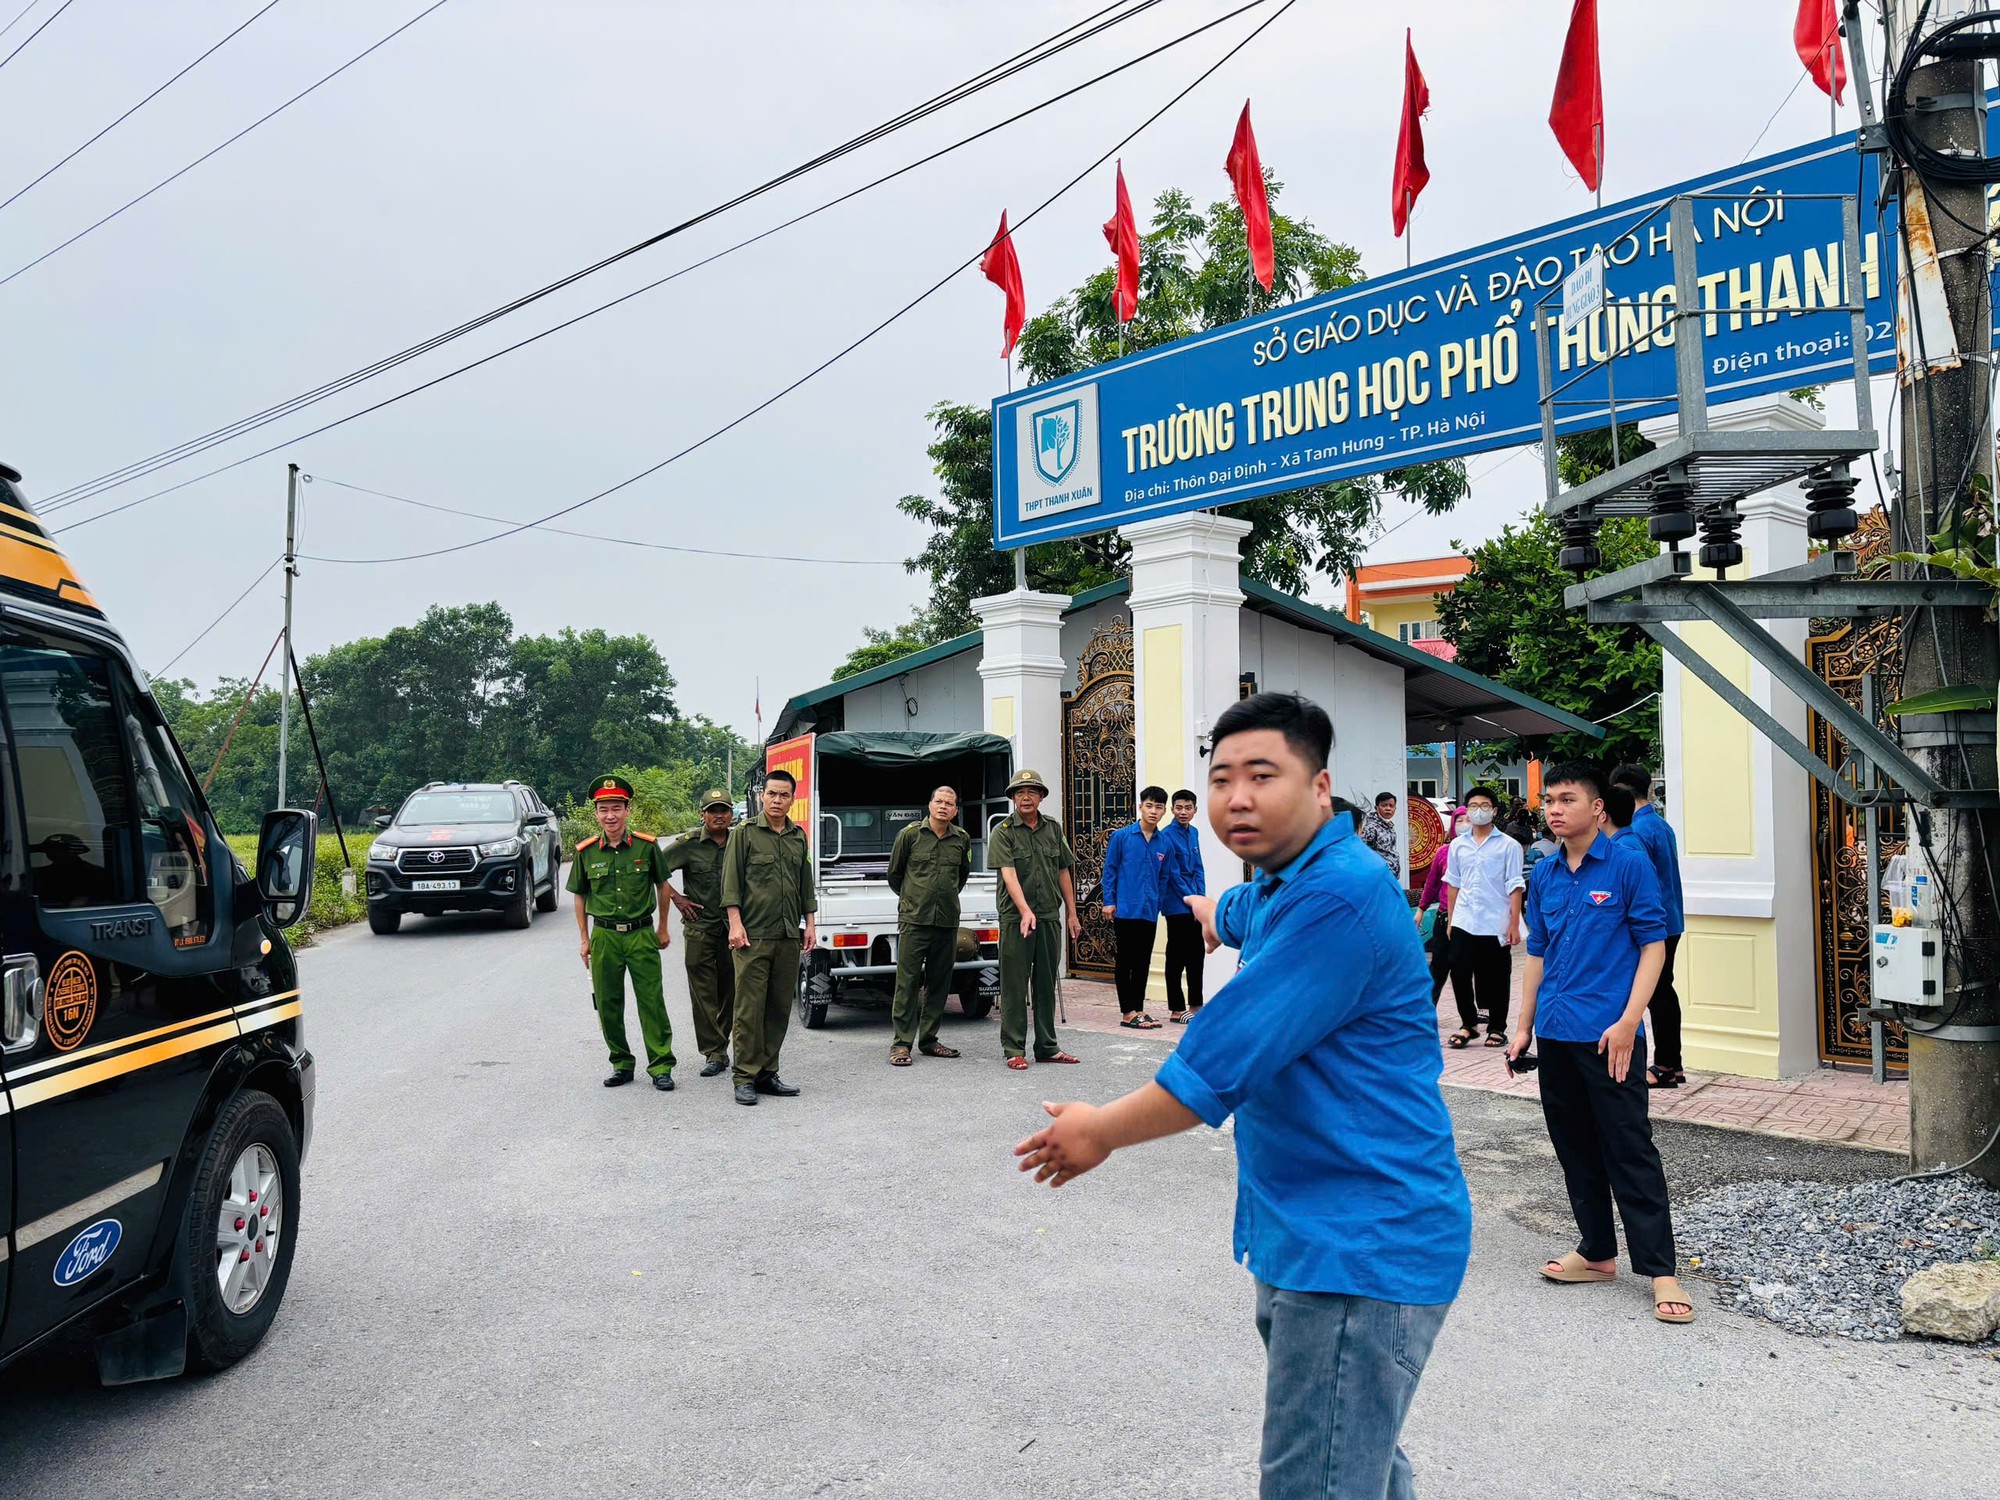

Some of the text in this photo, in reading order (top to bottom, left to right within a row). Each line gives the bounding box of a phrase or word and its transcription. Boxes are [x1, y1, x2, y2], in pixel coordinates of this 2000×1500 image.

[1253, 326, 1289, 366] SỞ
[1293, 310, 1362, 354] GIÁO
[1368, 295, 1428, 336] DỤC
[1435, 273, 1478, 314] VÀ
[1488, 255, 1564, 302] ĐÀO
[1649, 221, 1703, 256] H
[1713, 185, 1784, 238] NỘI
[1121, 402, 1235, 474] TRƯỜNG
[1241, 371, 1350, 444] TRUNG
[1358, 350, 1431, 421] HỌC
[1440, 298, 1524, 399] PHỔ
[1697, 232, 1881, 337] THANH
[1712, 350, 1768, 375] Điện
[1775, 331, 1850, 361] thoại:
[1124, 489, 1145, 504] Địa
[1147, 480, 1170, 497] chỉ:
[1173, 475, 1206, 492] Thôn
[1208, 468, 1231, 485] Đại
[1234, 459, 1267, 480] Định
[1280, 452, 1301, 468] Xã
[1304, 444, 1338, 462] Tam
[1342, 434, 1384, 454] Hưng
[1400, 425, 1424, 441] TP.
[1427, 417, 1450, 435] Hà
[1455, 410, 1486, 431] Nội
[1025, 486, 1093, 512] THPT THANH XUÂN
[65, 1227, 112, 1281] Ford
